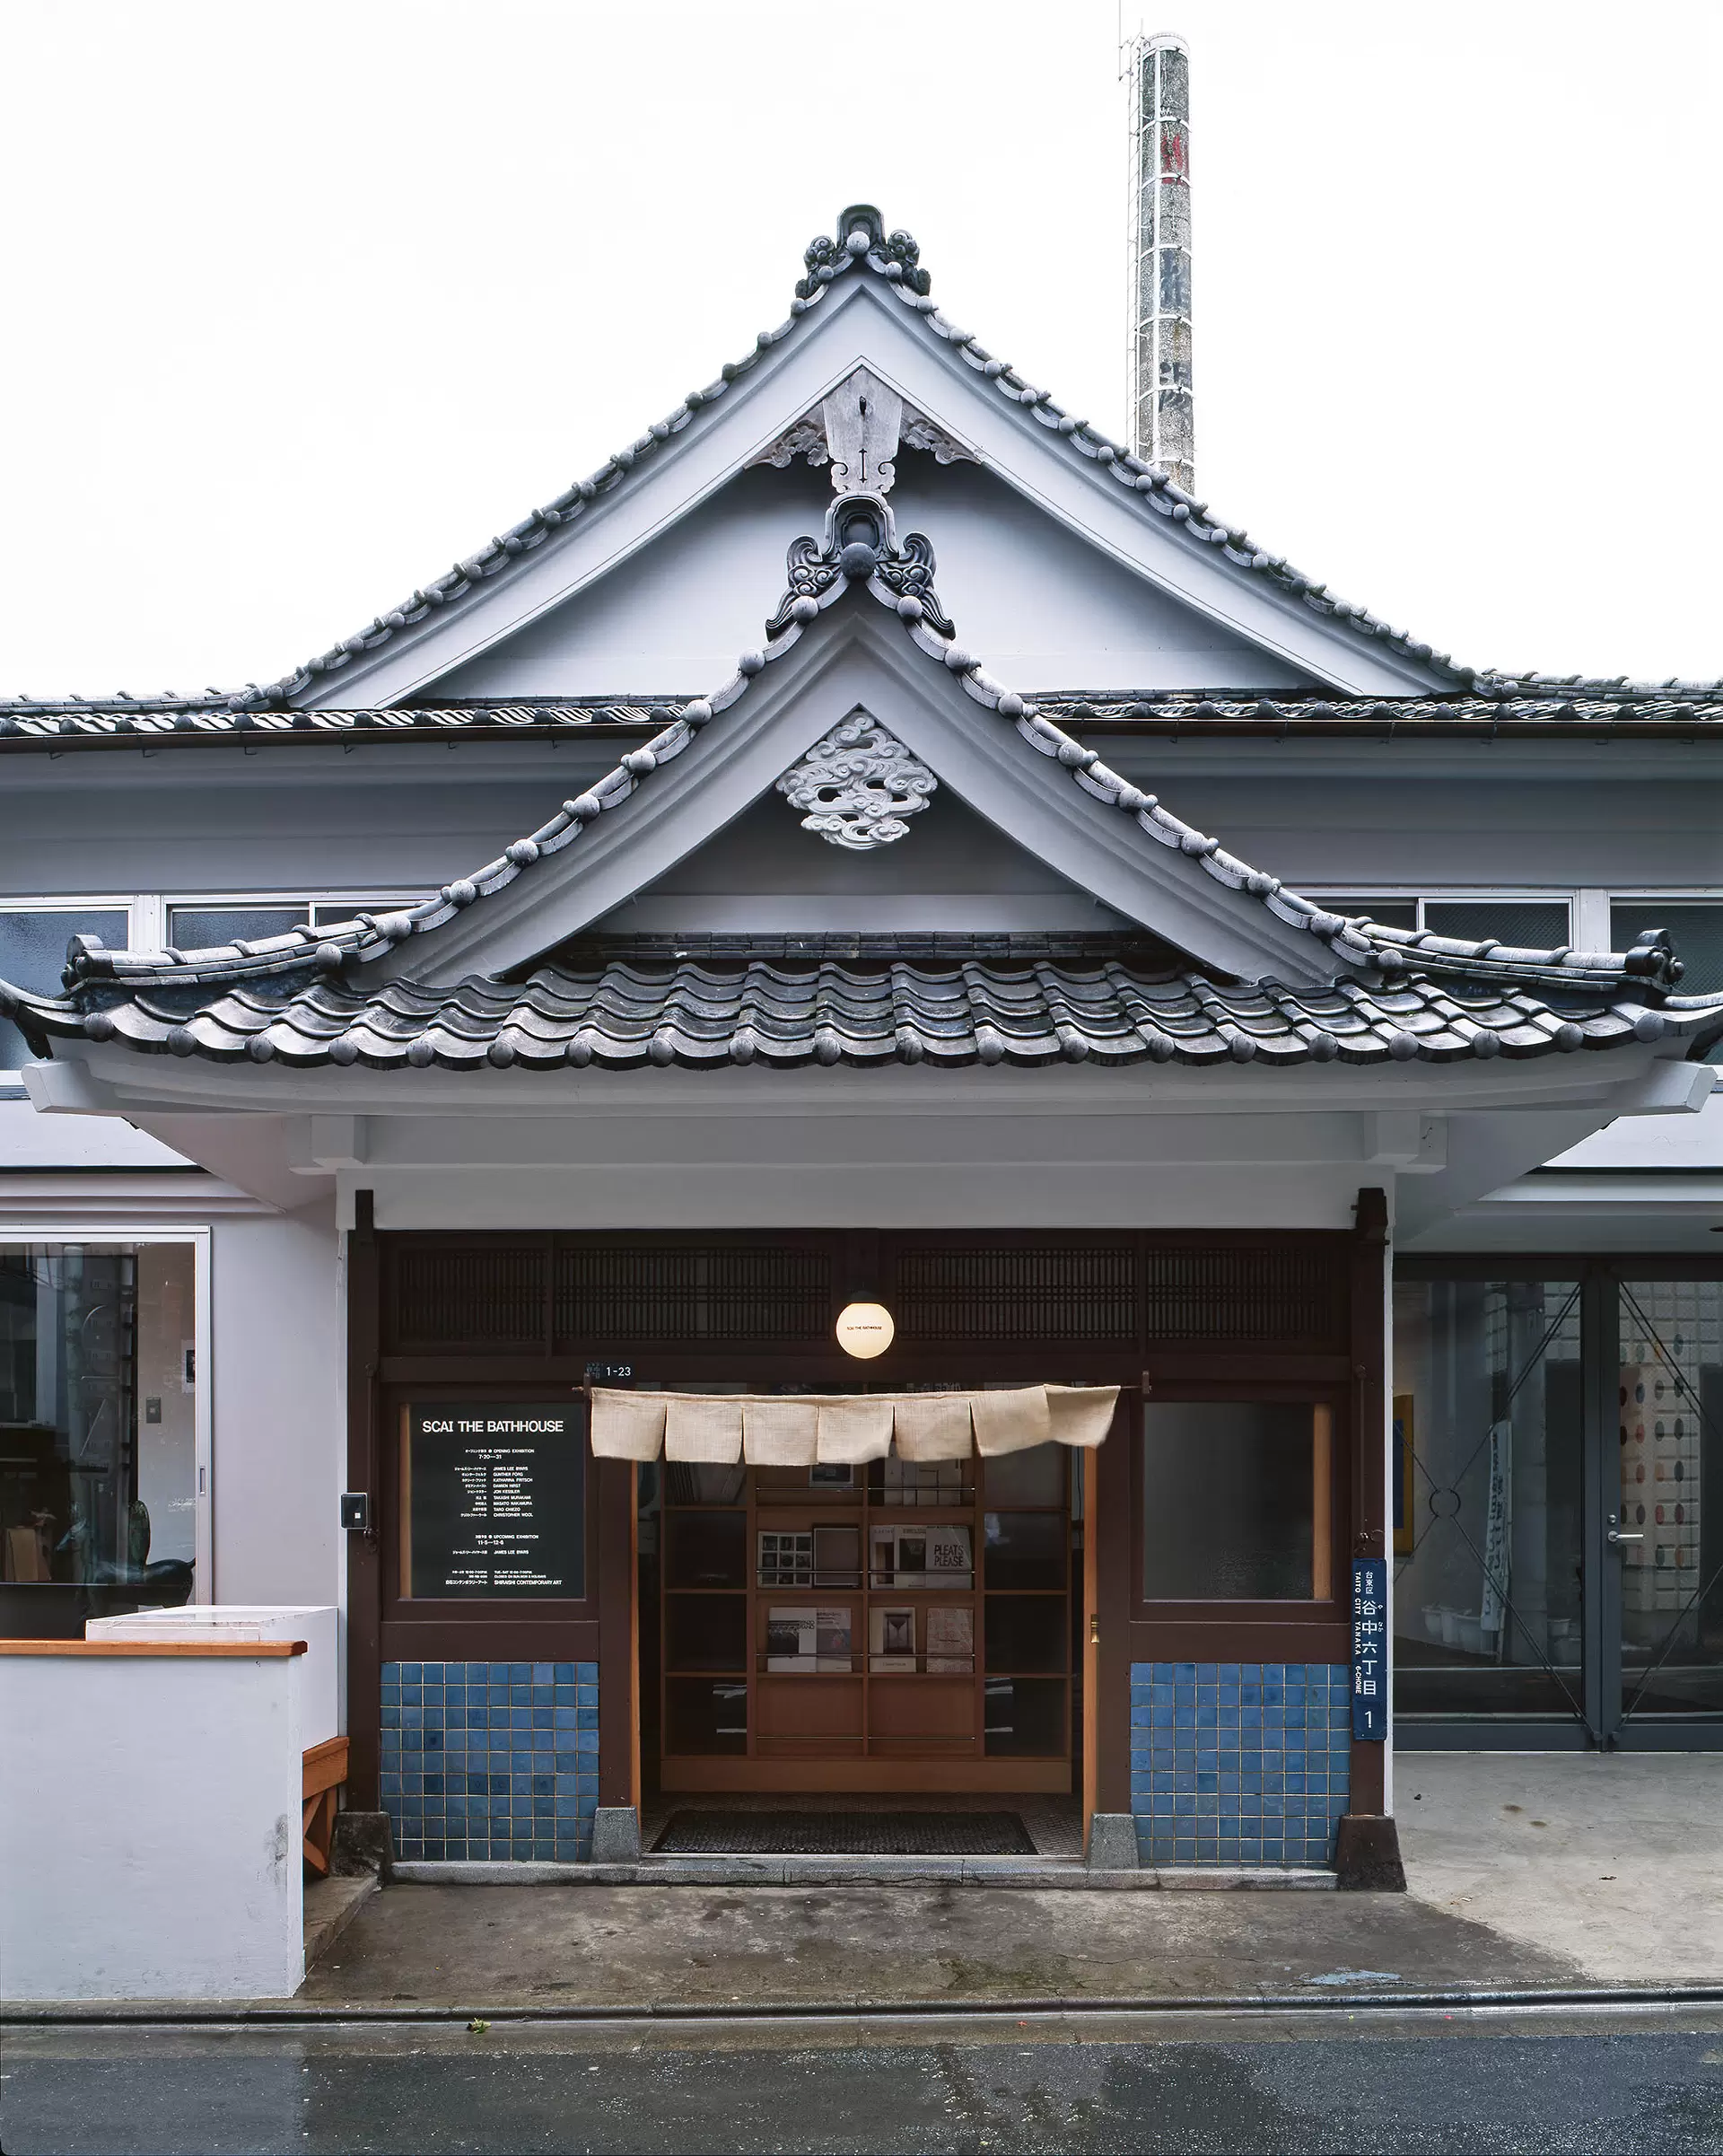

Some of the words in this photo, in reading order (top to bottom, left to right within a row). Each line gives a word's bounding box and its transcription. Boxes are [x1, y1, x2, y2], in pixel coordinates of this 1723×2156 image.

[606, 1366, 632, 1377] 1-23
[423, 1420, 453, 1433] SCAI
[458, 1420, 484, 1433] THE
[487, 1420, 564, 1433] BATHHOUSE
[934, 1544, 964, 1556] PLEATS
[934, 1556, 964, 1567] PLEASE
[1365, 1571, 1374, 1595] 台東区
[1361, 1599, 1378, 1696] 谷中六丁目
[1364, 1710, 1372, 1729] 1
